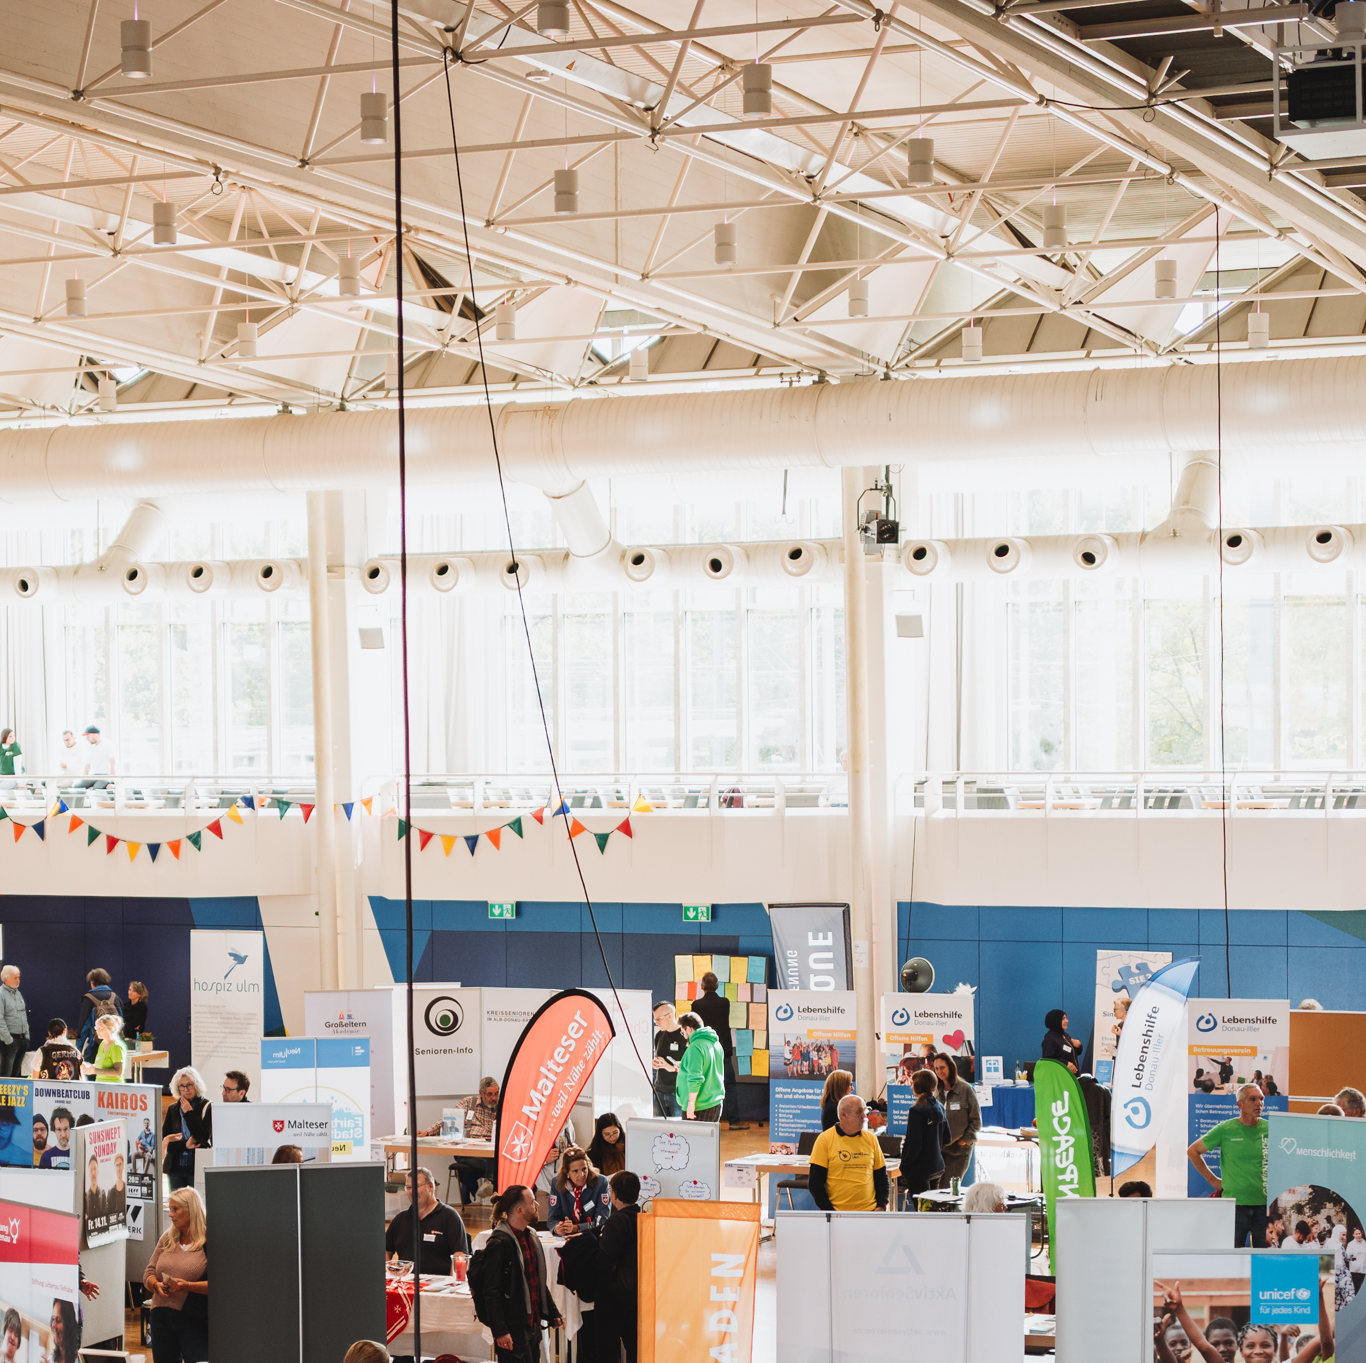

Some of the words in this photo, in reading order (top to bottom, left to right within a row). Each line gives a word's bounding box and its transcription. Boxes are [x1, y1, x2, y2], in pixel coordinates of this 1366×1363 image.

[194, 978, 232, 994] hospiz
[236, 980, 259, 993] ulm
[798, 1006, 845, 1014] Lebenshilfe
[914, 1011, 963, 1020] Lebenshilfe
[325, 1020, 366, 1029] Großeltern
[1222, 1016, 1277, 1025] Lebenshilfe
[415, 1047, 473, 1056] Senioren-Info
[1131, 1006, 1159, 1089] Lebenshilfe
[521, 1010, 588, 1121] Malteser
[564, 1060, 585, 1093] Nähe
[584, 1031, 605, 1060] zählt.
[1145, 1033, 1164, 1091] Donau-Iller
[35, 1088, 91, 1100] DOWNBEATCLUB
[3, 1095, 26, 1107] JAZZ
[97, 1090, 148, 1111] KAIROS
[288, 1119, 328, 1130] Malteser
[89, 1126, 121, 1145] SUNSWEPT
[93, 1142, 117, 1157] SUNDAY
[1296, 1147, 1357, 1161] Menschlichkeit
[1259, 1288, 1296, 1300] unicef
[1259, 1306, 1270, 1314] für
[1271, 1306, 1291, 1315] jedes
[1293, 1306, 1310, 1314] Kind
